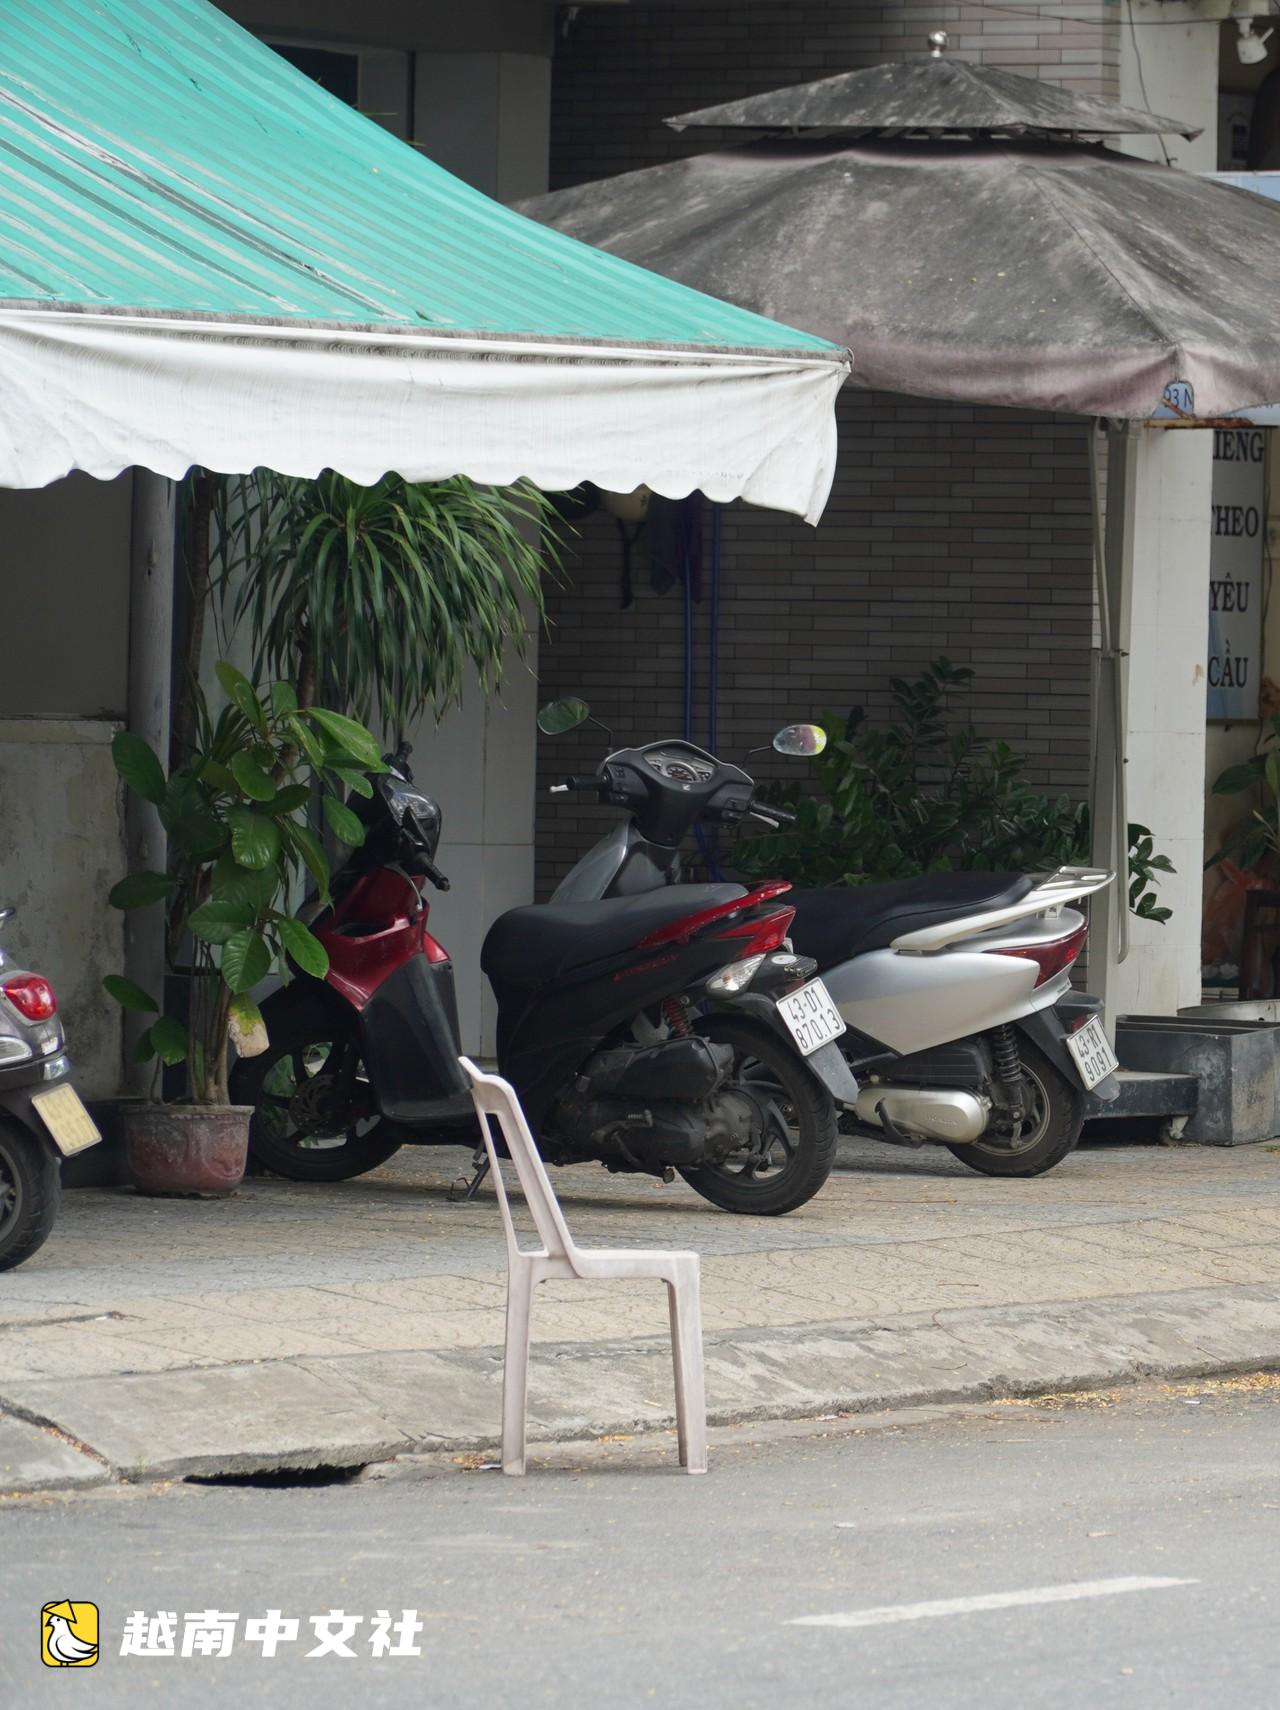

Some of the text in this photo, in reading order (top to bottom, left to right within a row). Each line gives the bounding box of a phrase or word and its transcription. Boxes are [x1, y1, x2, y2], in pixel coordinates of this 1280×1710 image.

[1209, 572, 1250, 613] YÊU
[1207, 638, 1249, 688] CẦU
[795, 1009, 841, 1049] 870.13
[1084, 1047, 1112, 1082] 9091
